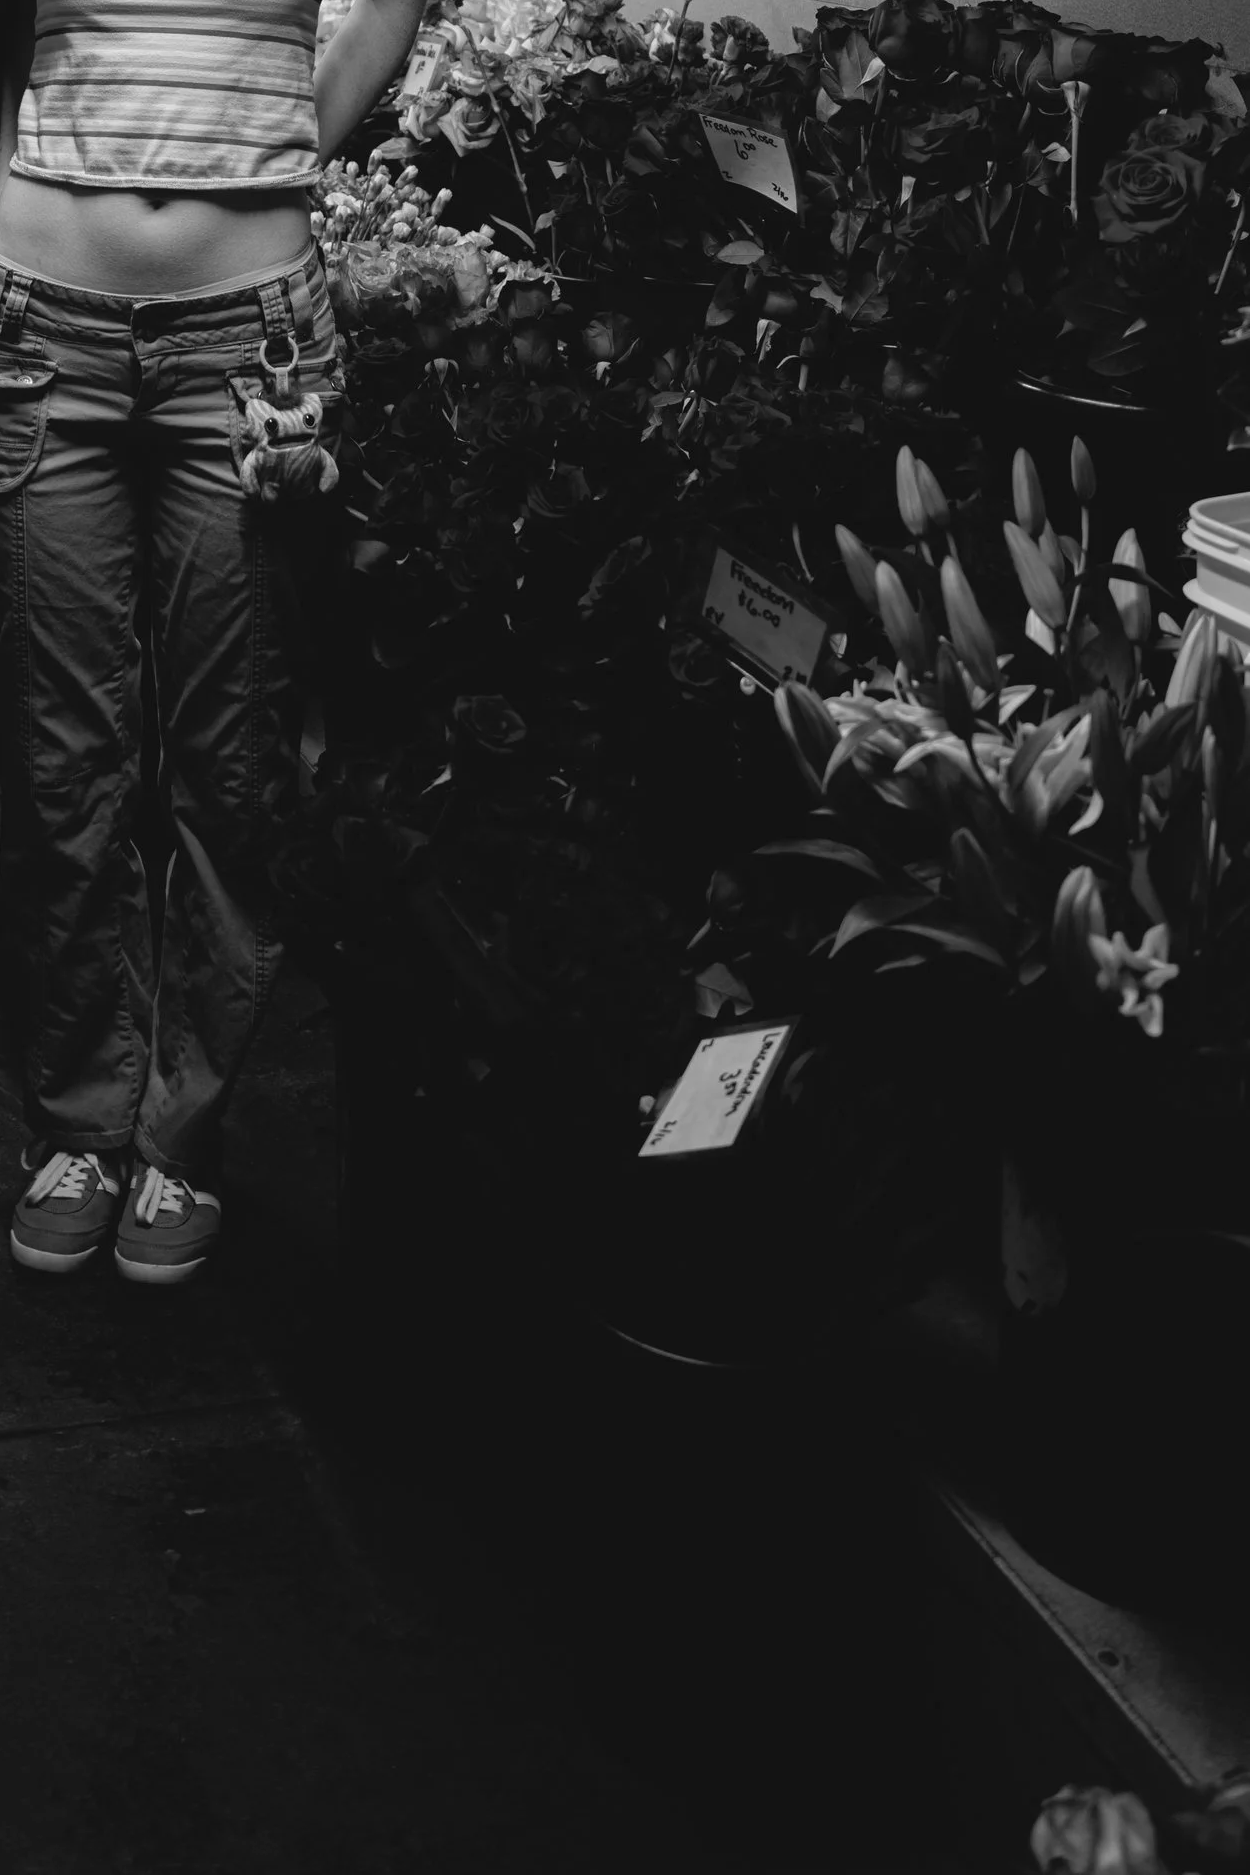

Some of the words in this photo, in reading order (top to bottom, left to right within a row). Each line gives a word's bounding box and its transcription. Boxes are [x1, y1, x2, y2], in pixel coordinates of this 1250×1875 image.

[702, 115, 747, 138] Freedom
[747, 127, 778, 148] Rose
[730, 559, 795, 615] Freedom
